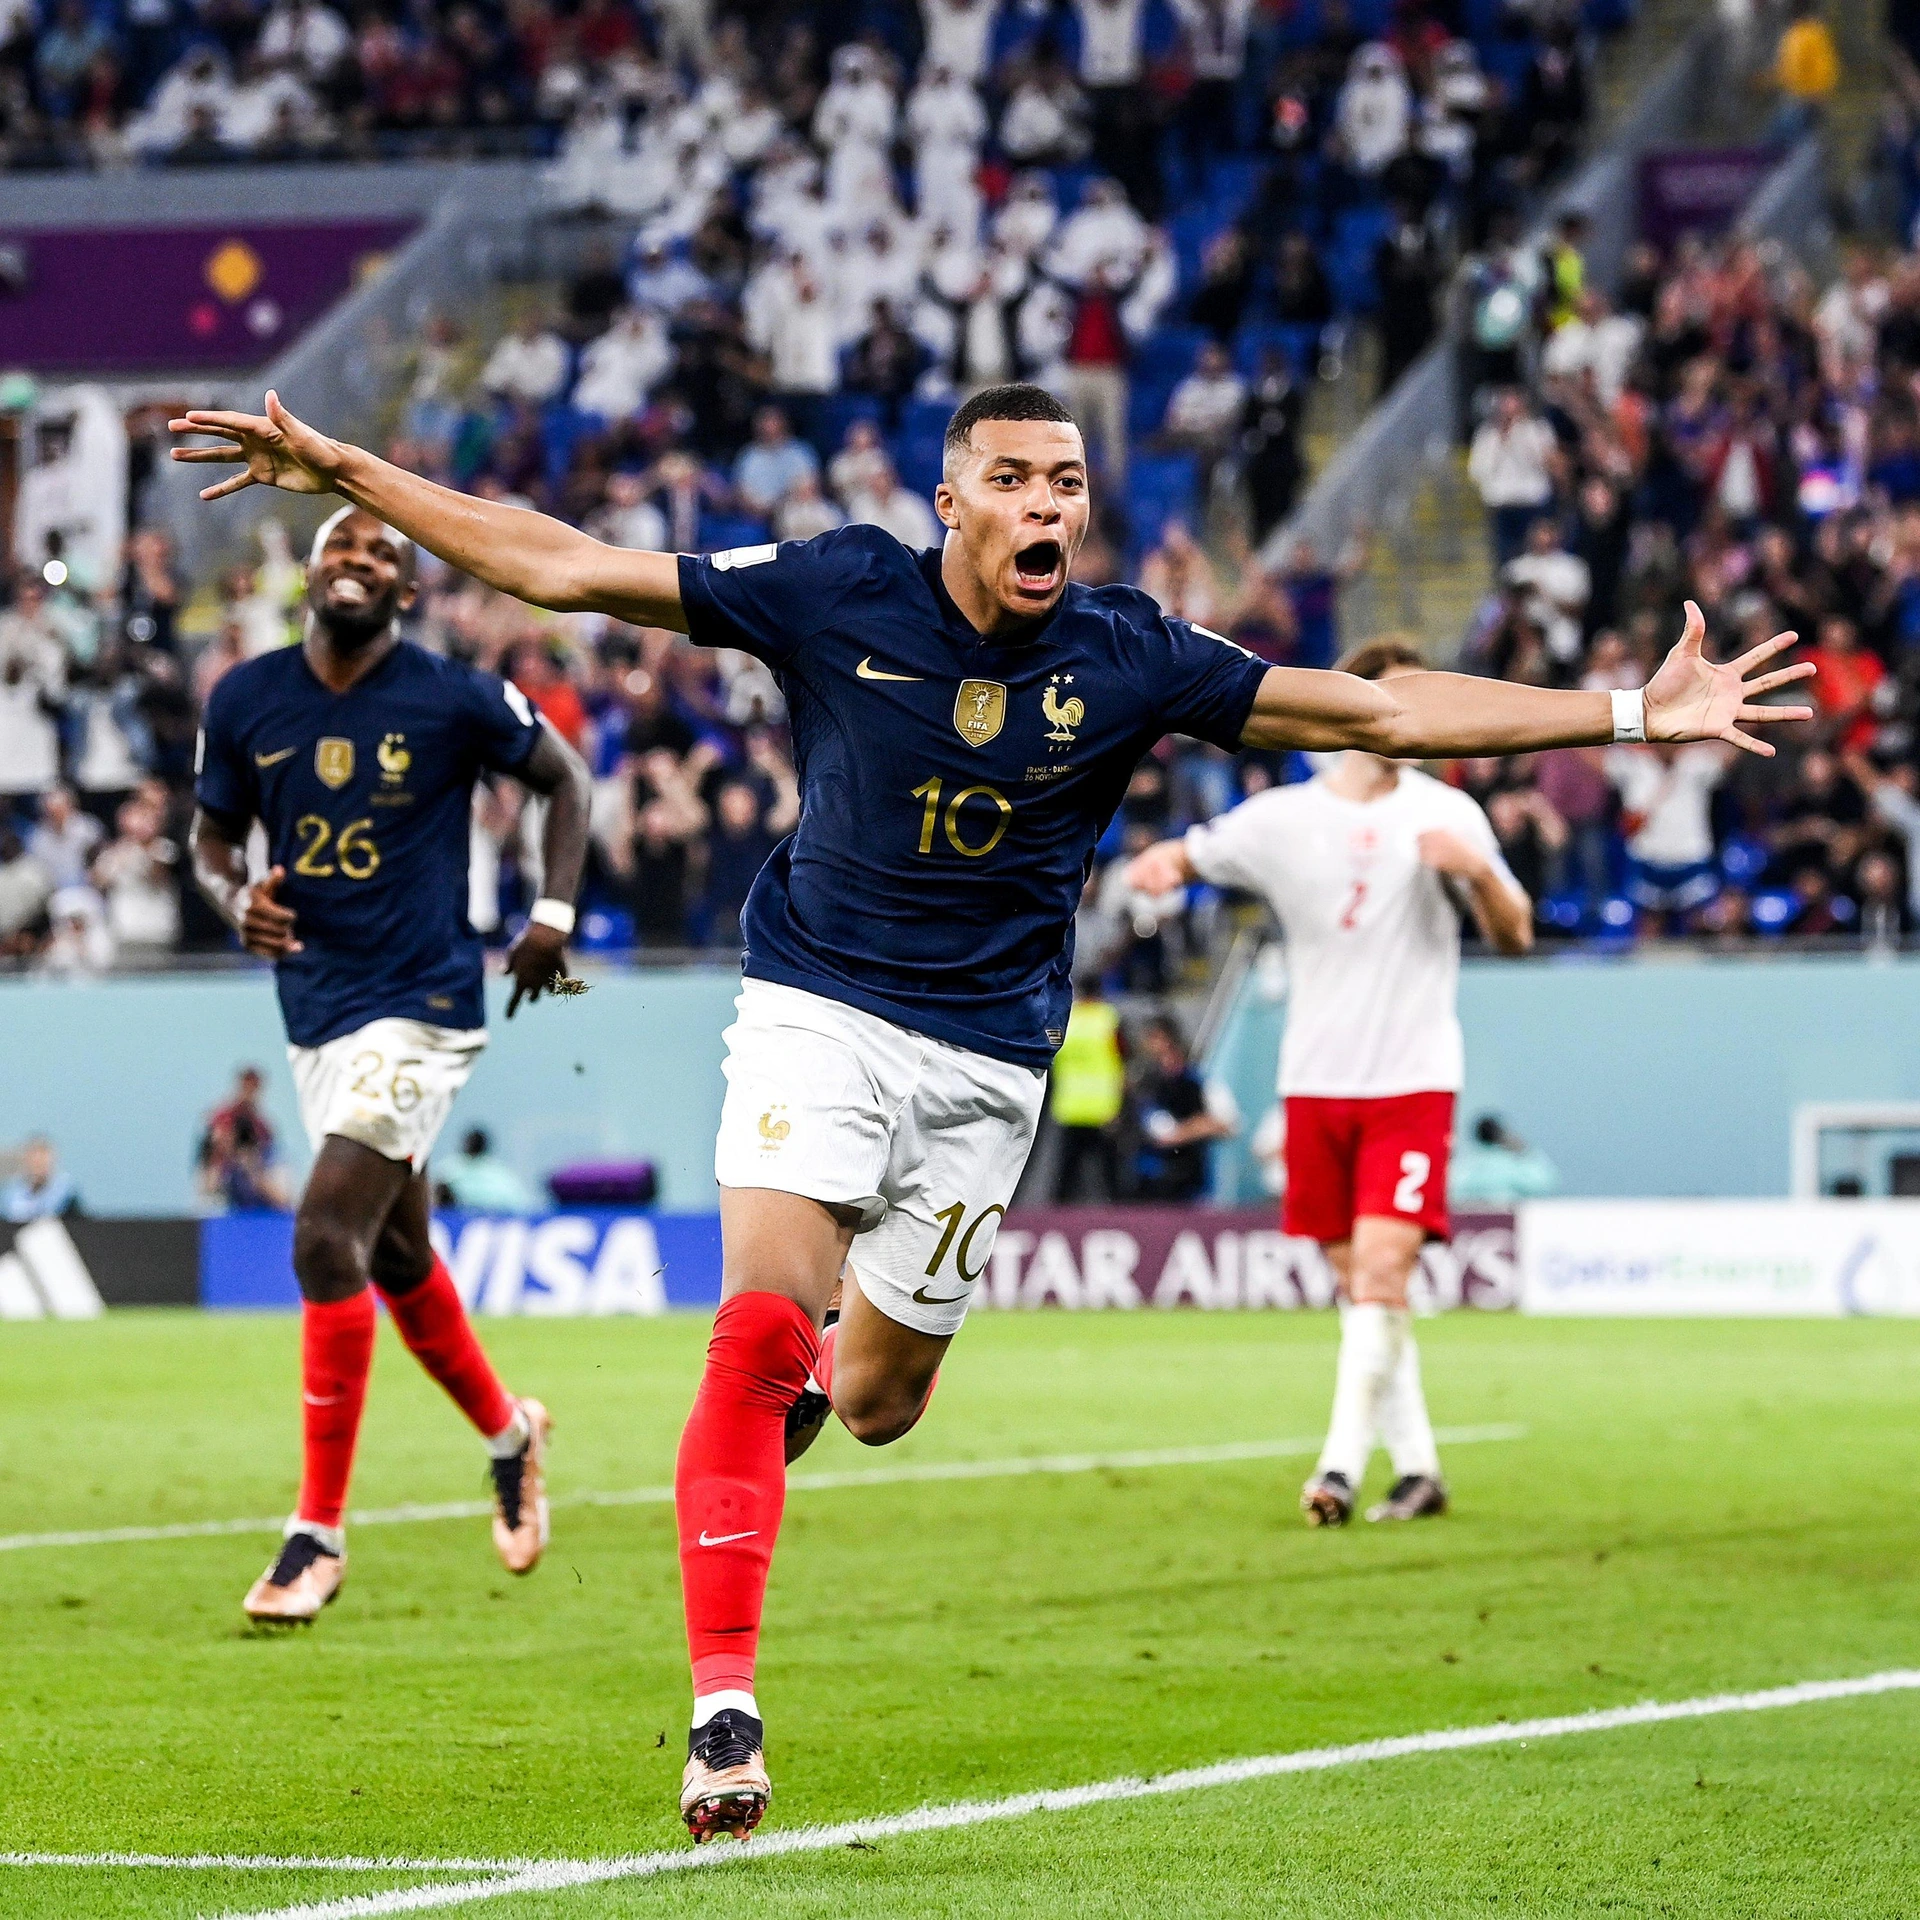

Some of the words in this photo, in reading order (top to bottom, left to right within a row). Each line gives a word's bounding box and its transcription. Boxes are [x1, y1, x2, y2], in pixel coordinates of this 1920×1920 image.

[968, 721, 988, 731] FIFA
[295, 814, 381, 880] 26
[910, 776, 1013, 857] 10
[350, 1050, 423, 1113] 26
[1393, 1149, 1431, 1214] 2
[427, 1216, 668, 1315] VISA
[924, 1200, 1005, 1282] 10
[969, 1229, 1143, 1309] TAR
[1153, 1229, 1514, 1310] AIRYS
